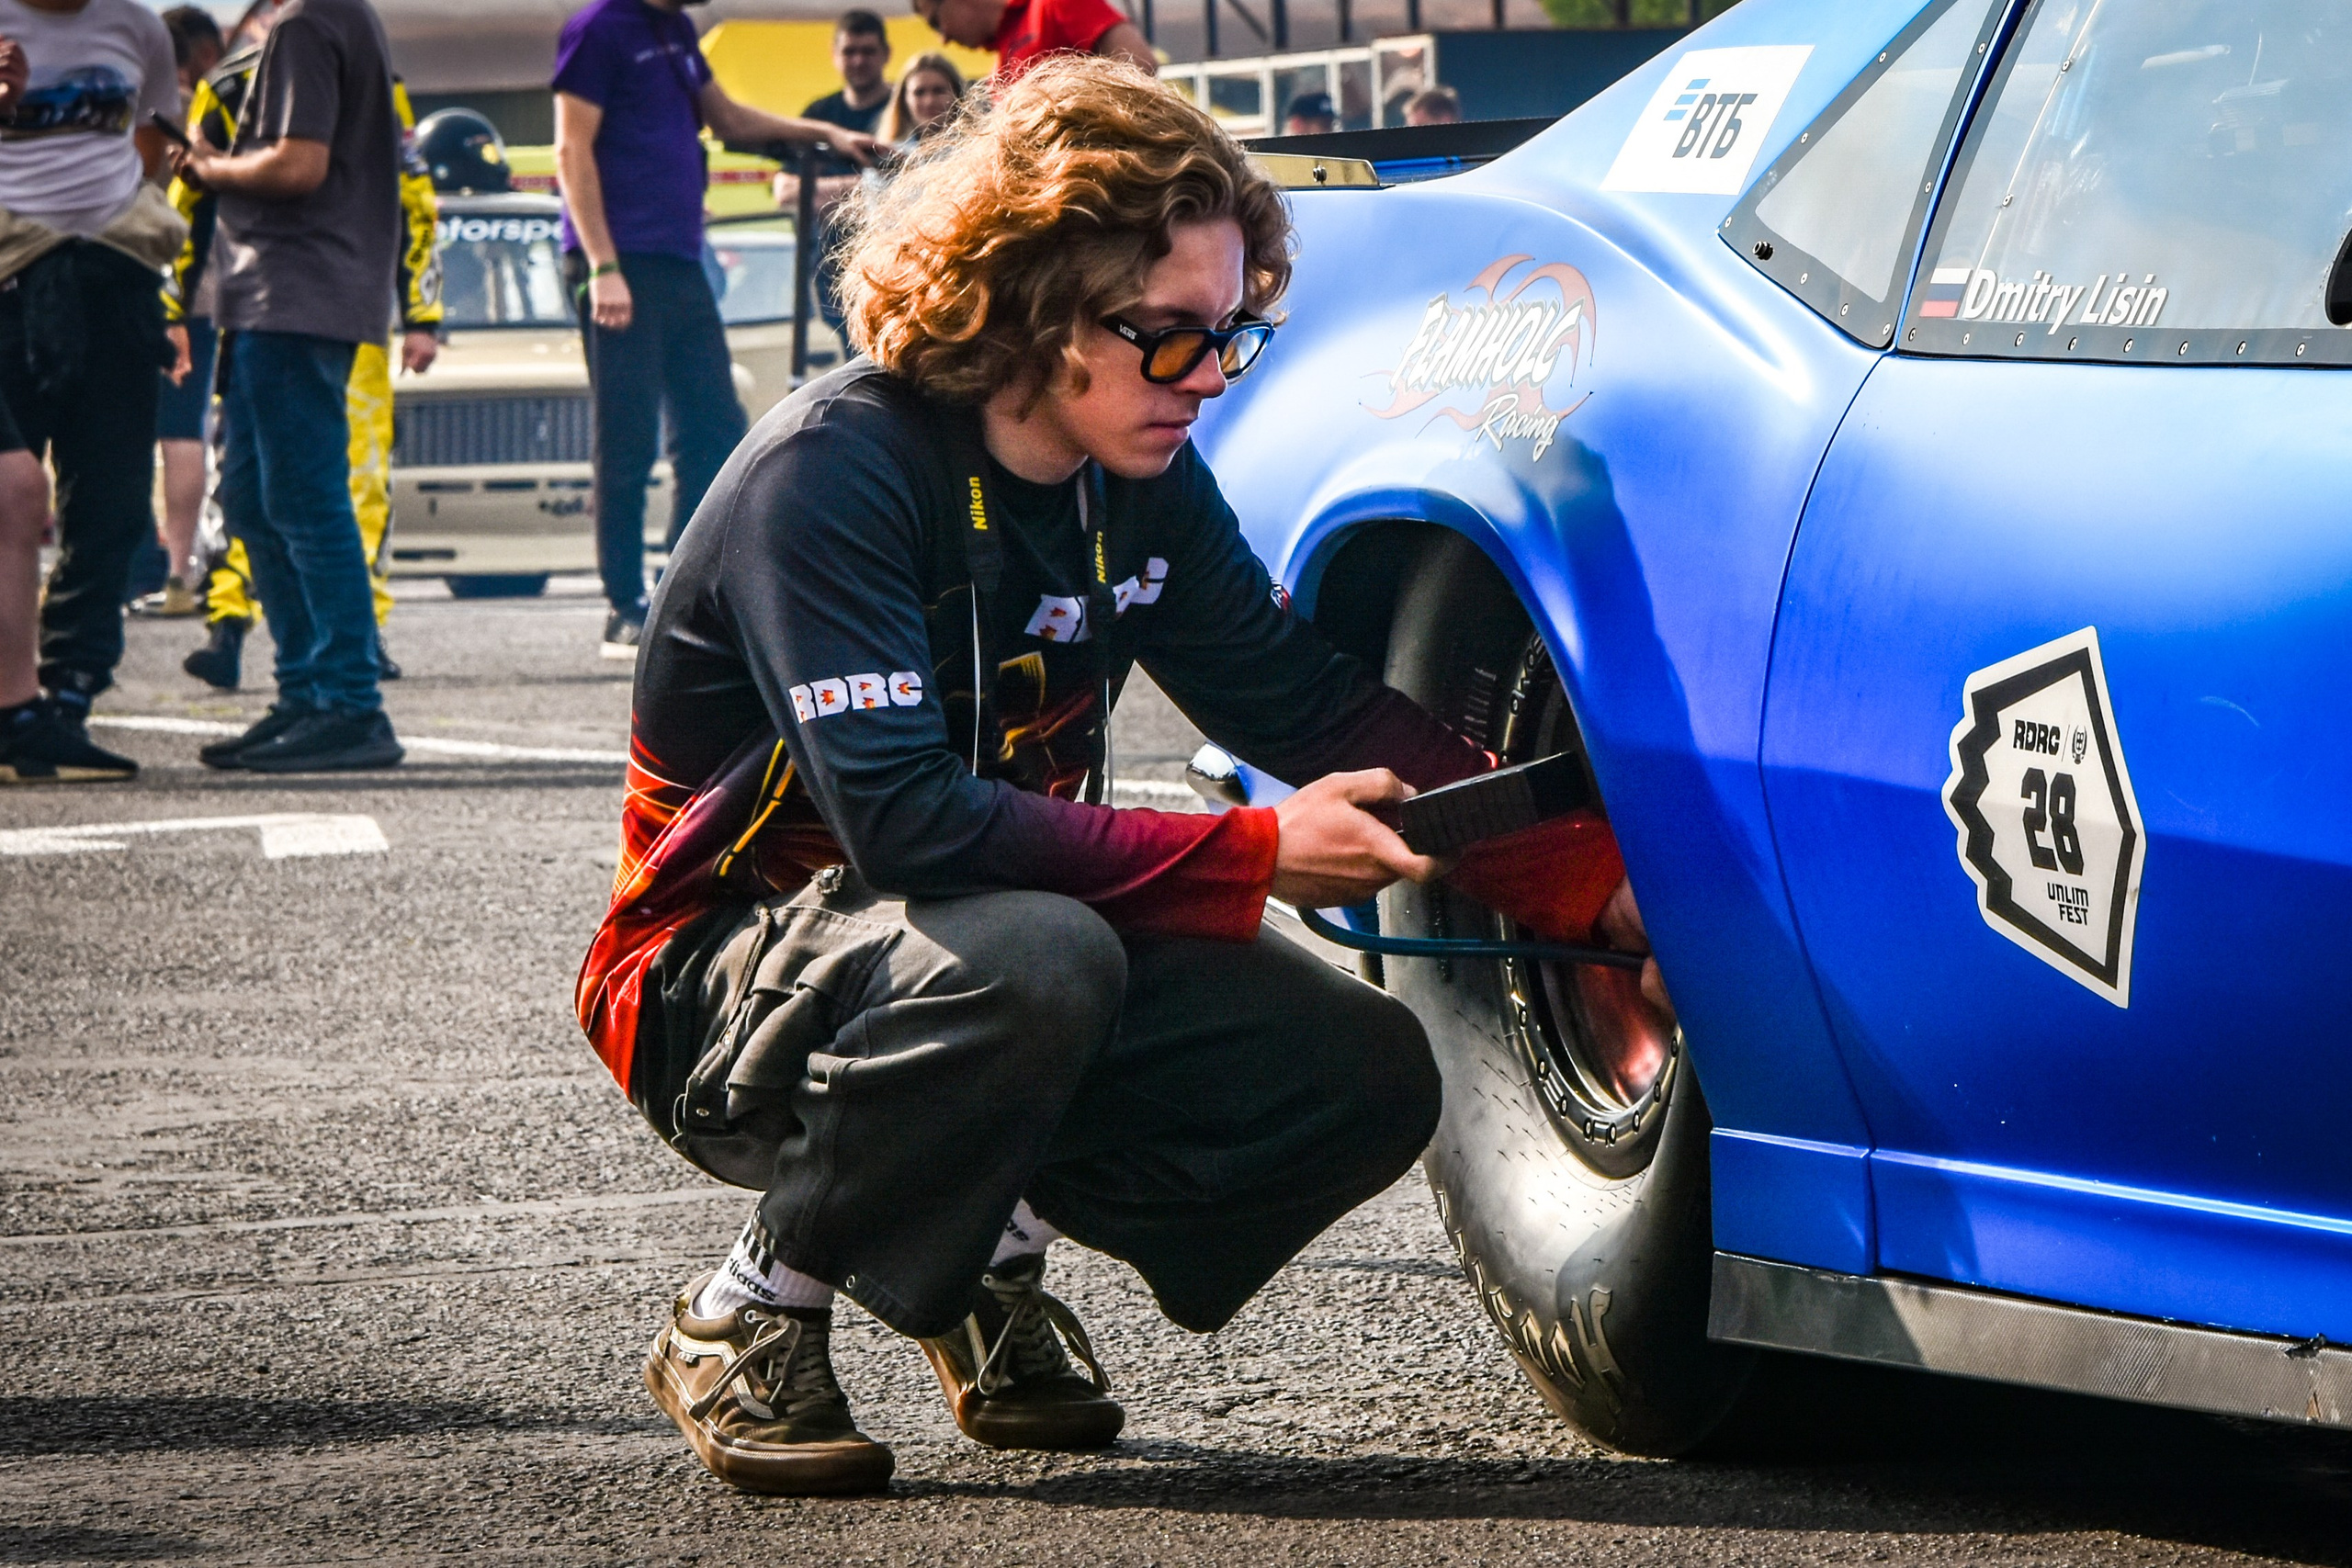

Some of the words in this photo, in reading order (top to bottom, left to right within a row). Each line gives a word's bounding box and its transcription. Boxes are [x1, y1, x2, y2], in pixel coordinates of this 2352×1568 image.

[1672, 93, 1758, 159] ВТБ
[1962, 269, 2085, 335] Dmitry
[2079, 273, 2169, 326] Lisin
[1476, 393, 1560, 462] Racing
[968, 476, 989, 531] Nikon
[1094, 530, 1107, 584] Nikon
[788, 671, 923, 724] RDRC
[2013, 718, 2061, 756] RDRC
[2020, 767, 2085, 876] 28
[2058, 902, 2088, 926] FEST
